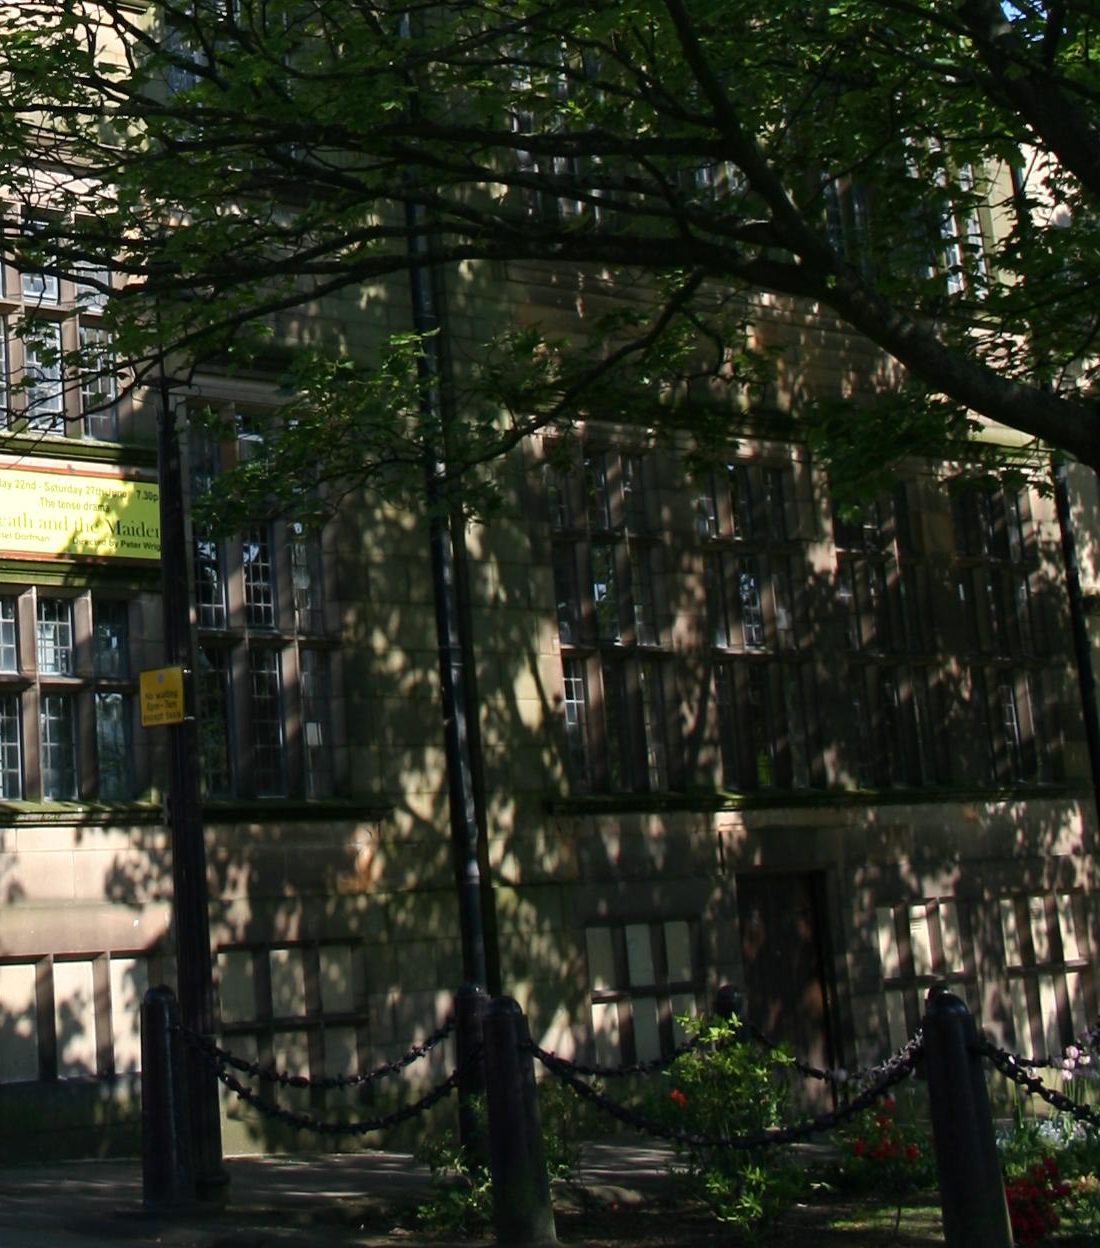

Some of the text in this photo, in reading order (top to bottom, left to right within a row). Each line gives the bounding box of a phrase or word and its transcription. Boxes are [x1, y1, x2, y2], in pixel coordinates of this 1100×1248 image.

[15, 479, 36, 490] 22nd
[44, 481, 83, 496] Saturday
[136, 489, 159, 502] 7.30p
[40, 497, 110, 512] The tense drama
[38, 514, 68, 531] and
[74, 516, 99, 533] the
[14, 533, 51, 542] Dorfman
[72, 537, 107, 547] Directed
[108, 538, 118, 548] by
[120, 540, 141, 549] Peter
[143, 541, 160, 552] Wrig
